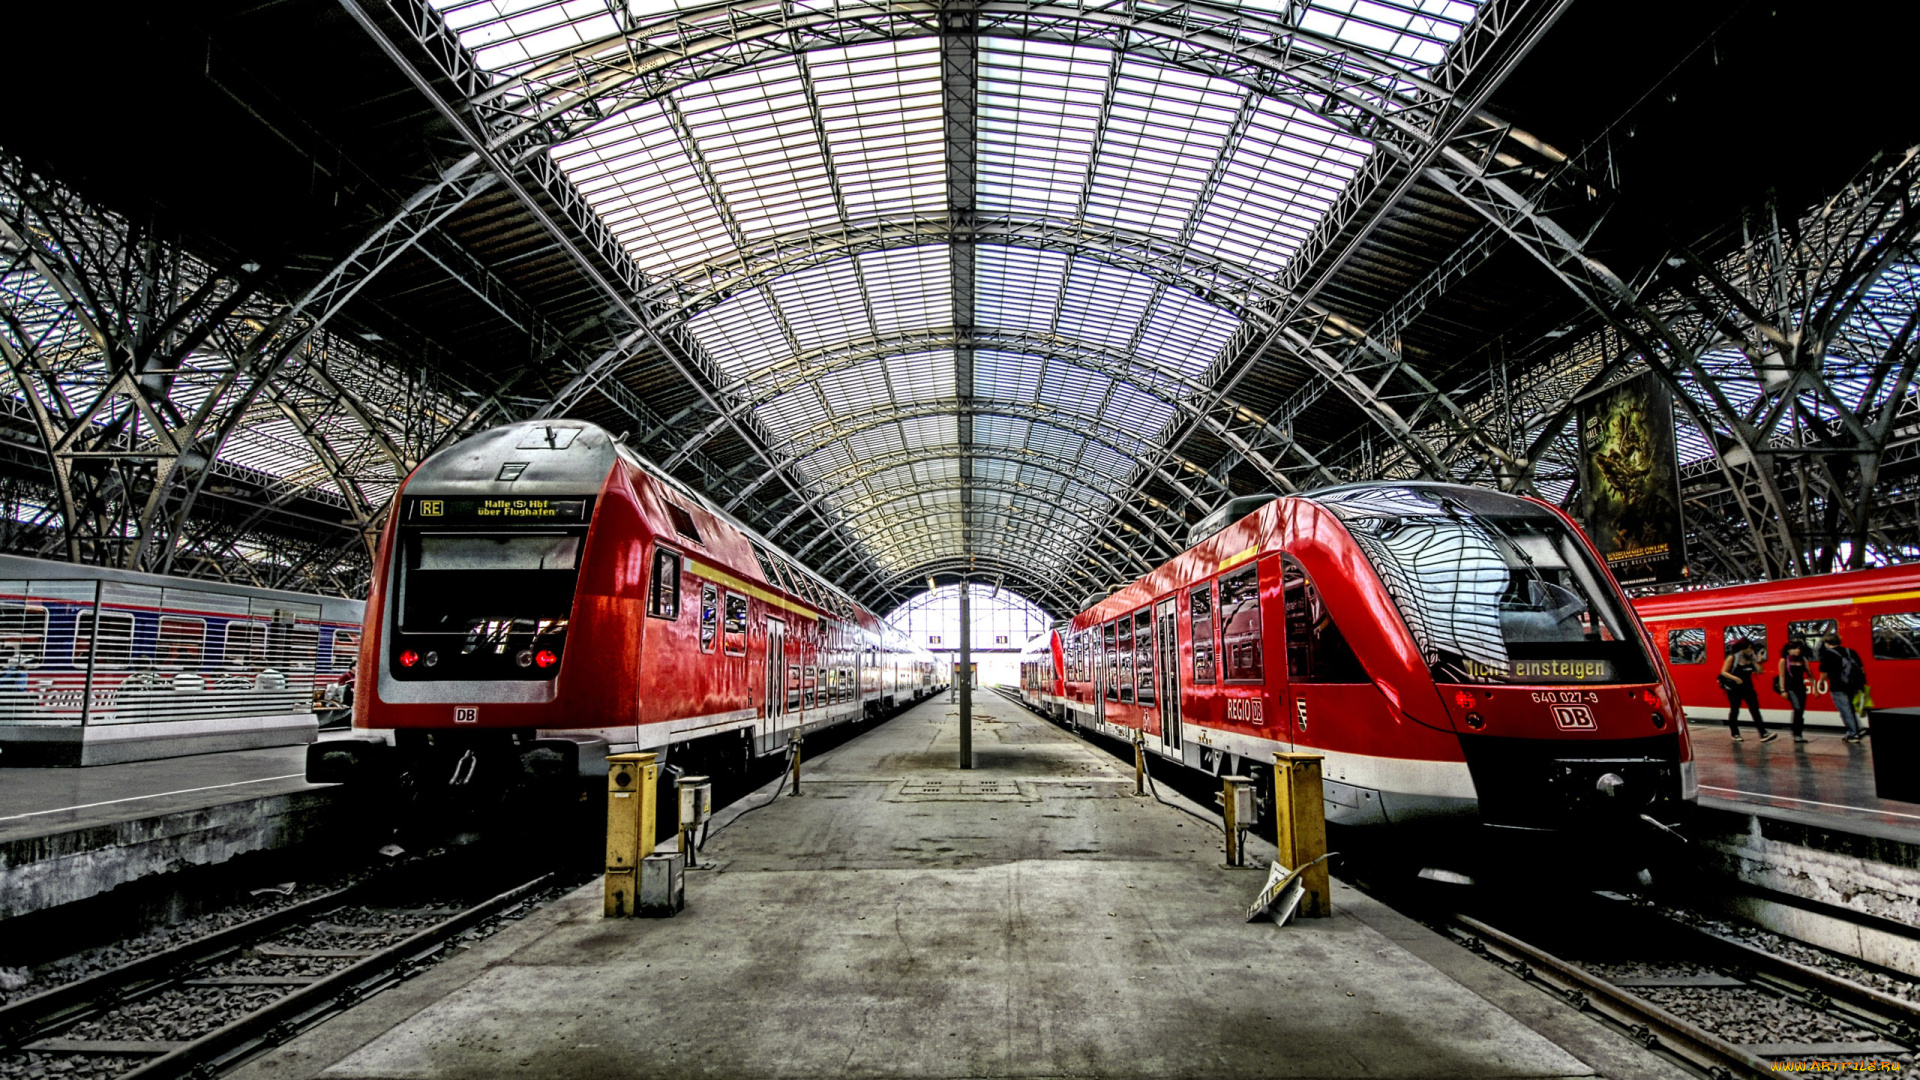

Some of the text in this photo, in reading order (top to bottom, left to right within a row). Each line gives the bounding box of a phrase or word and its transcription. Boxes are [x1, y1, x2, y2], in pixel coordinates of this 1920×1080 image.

[422, 502, 441, 515] RE
[484, 500, 549, 508] Halle (S) Hbf
[478, 508, 556, 517] über Flughafen
[1515, 660, 1605, 679] einsteigen
[1531, 692, 1558, 704] 640
[456, 708, 477, 722] DB
[1227, 698, 1251, 721] REGIO
[1555, 707, 1594, 729] DB
